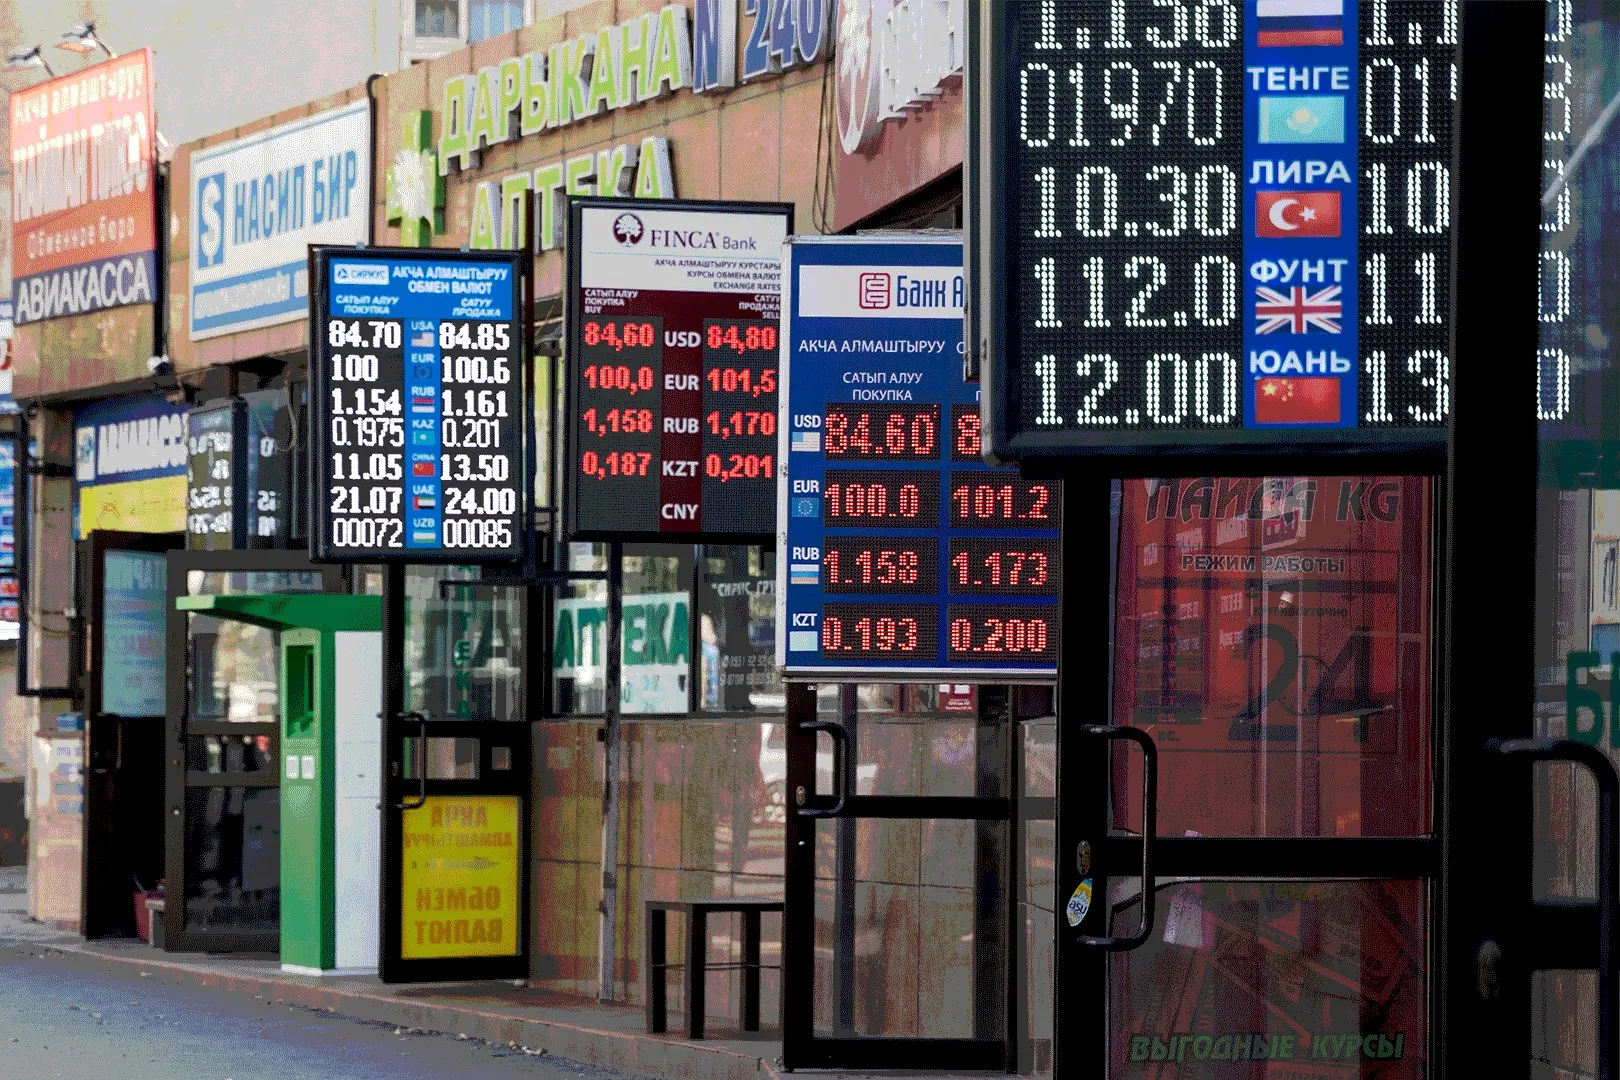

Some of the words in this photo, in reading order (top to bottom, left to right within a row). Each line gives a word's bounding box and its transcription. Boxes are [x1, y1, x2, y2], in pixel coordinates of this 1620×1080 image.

[439, 5, 692, 175] ДАРЫКАНА
[1247, 67, 1350, 91] ТЕНГЕ
[1020, 61, 1223, 147] 01970
[1249, 160, 1351, 185] ЛИРА
[234, 165, 306, 248] НАСИП
[312, 151, 357, 225] БИР
[1034, 163, 1237, 238] 10.30
[650, 229, 718, 250] FINCA
[723, 236, 757, 250] Bank
[392, 266, 424, 278] АКЧА
[426, 267, 508, 281] АЛМАШТЫРУУ
[655, 259, 677, 267] АКЧА
[678, 260, 737, 269] АЛМАШТЫРУУ
[739, 262, 781, 270] КУРСТАРЫ
[687, 271, 715, 279] КУРСЫ
[716, 272, 751, 280] ОБМЕНА
[753, 273, 781, 281] ВАЛЮТ
[1250, 259, 1349, 284] ФУНТ
[16, 258, 151, 323] АВИАКАССА
[408, 281, 449, 294] ОБМЕН
[452, 282, 493, 295] ВАЛЮТ
[585, 289, 615, 297] САТЫП
[616, 290, 639, 299] АЛУУ
[713, 281, 756, 290] EXCHANGE
[757, 283, 781, 291] RATES
[897, 275, 946, 308] Банк
[1034, 255, 1237, 328] 112.0
[336, 295, 370, 305] САТЫП
[372, 296, 399, 305] АЛУУ
[344, 305, 390, 314] ПОКУПКА
[452, 308, 501, 318] ПРОДАЖА
[461, 298, 493, 307] САТУУ
[585, 298, 625, 306] ПОКУПКА
[585, 306, 602, 314] BUY
[739, 302, 780, 311] ПРОДАЖА
[411, 321, 434, 330] USA
[762, 311, 780, 319] SELL
[329, 320, 401, 348] 84.70
[439, 322, 510, 350] 84.85
[584, 322, 655, 352] 84,60
[665, 331, 701, 348] USD
[707, 324, 777, 354] 84,80
[799, 341, 837, 353] АКЧА
[841, 341, 945, 354] АЛМАШТЫРУУ
[332, 354, 378, 381] 100
[411, 354, 434, 363] EUR
[442, 356, 510, 384] 100.6
[1250, 350, 1351, 374] ЮАНЬ
[412, 386, 435, 396] RUB
[584, 365, 653, 395] 100,0
[665, 374, 700, 391] EUR
[707, 368, 776, 398] 101,5
[843, 372, 887, 384] САТЫП
[889, 373, 923, 385] АЛУУ
[1034, 352, 1237, 424] 12.00
[332, 388, 401, 415] 1.154
[442, 390, 508, 417] 1.161
[853, 390, 912, 401] ПОКУПКА
[332, 418, 404, 447] 0.1975
[413, 420, 435, 429] KAZ
[442, 419, 500, 447] 0.201
[583, 409, 653, 437] 1,158
[664, 418, 699, 434] RUB
[707, 411, 776, 440] 1,170
[794, 415, 821, 428] USD
[825, 413, 935, 454] 84.60
[332, 453, 402, 480] 11.05
[440, 454, 508, 481] 13.50
[582, 452, 652, 481] 0,187
[662, 460, 699, 477] KZT
[706, 454, 773, 483] 0,201
[413, 485, 435, 494] UAE
[793, 480, 819, 493] EUR
[330, 487, 403, 514] 21.07
[445, 488, 515, 515] 24.00
[662, 504, 698, 520] CNY
[824, 484, 918, 517] 100.0
[953, 485, 1048, 519] 101.2
[1336, 479, 1400, 524] KG
[333, 518, 403, 548] 00072
[413, 518, 435, 528] UZB
[443, 519, 512, 548] 00085
[793, 547, 819, 560] RUB
[823, 550, 918, 584] 1.158
[1182, 555, 1256, 573] РЕЖИМ
[1262, 555, 1346, 573] РАБОТЫ
[952, 552, 1047, 585] 1.173
[792, 614, 817, 626] KZT
[822, 617, 917, 650] 0.193
[951, 618, 1047, 652] 0.200
[1228, 624, 1383, 743] 24
[1069, 900, 1088, 914] asu
[1312, 1033, 1405, 1061] КУРСЫ
